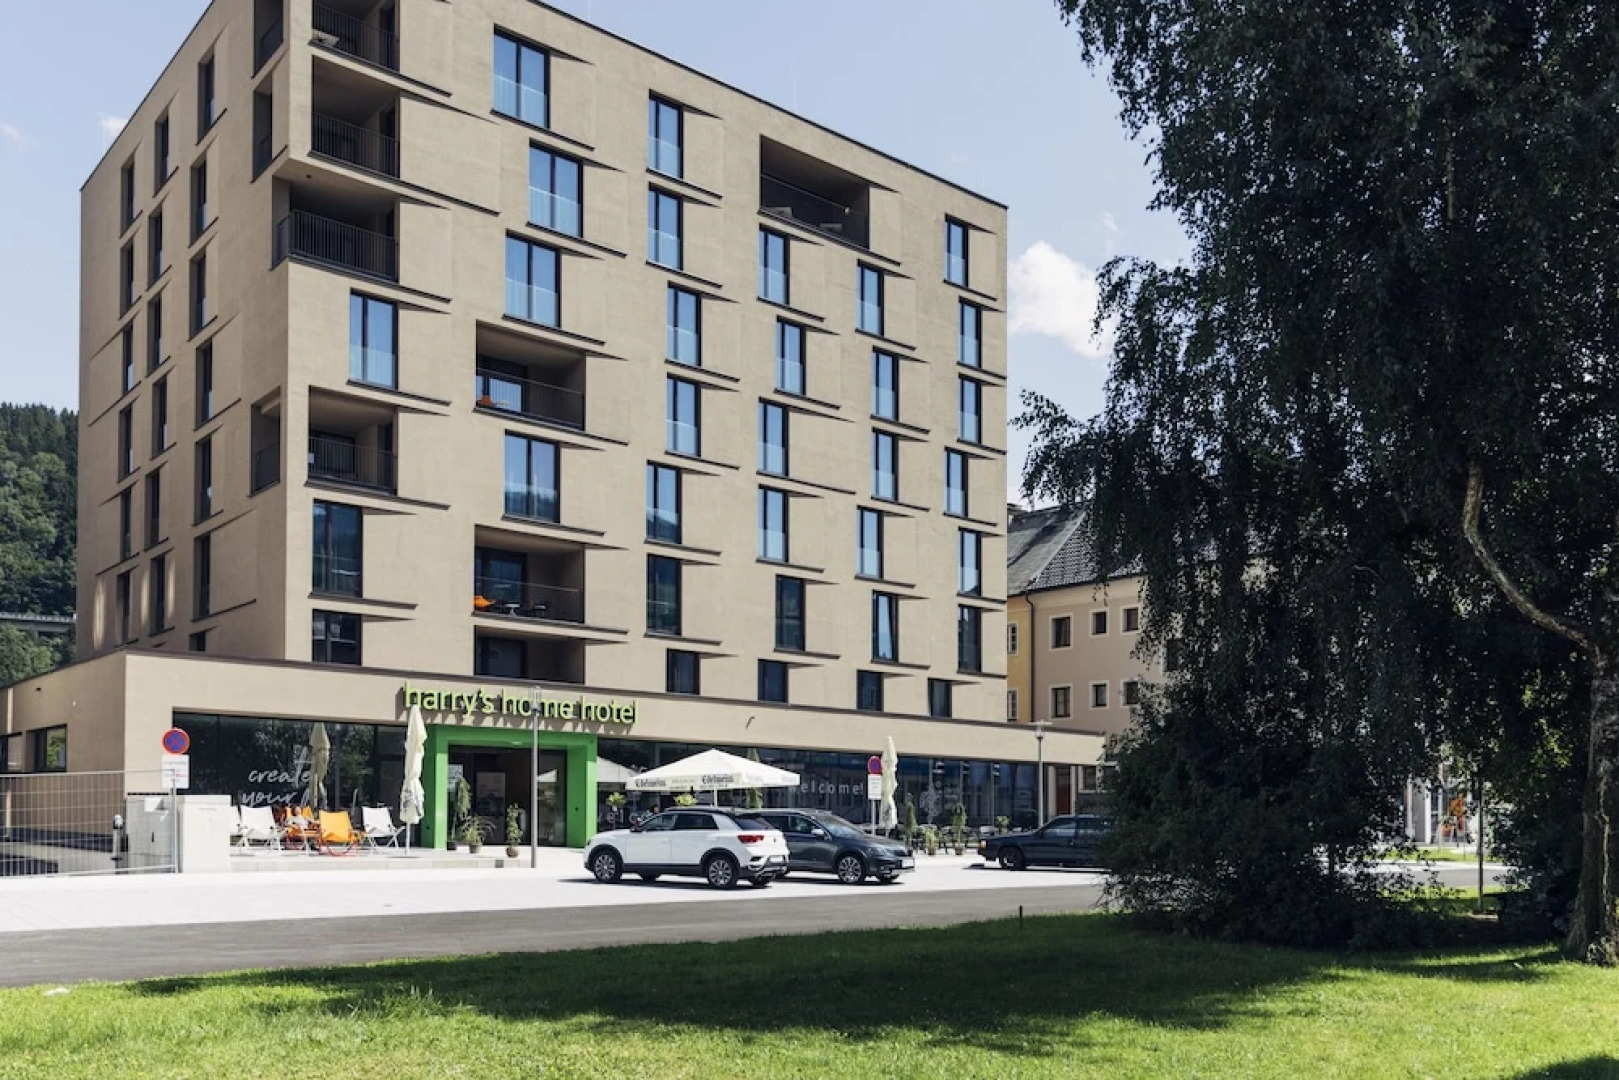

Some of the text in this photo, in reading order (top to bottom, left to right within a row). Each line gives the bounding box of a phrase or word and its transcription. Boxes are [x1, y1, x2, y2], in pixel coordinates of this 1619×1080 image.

[404, 681, 639, 725] harry's home hotel
